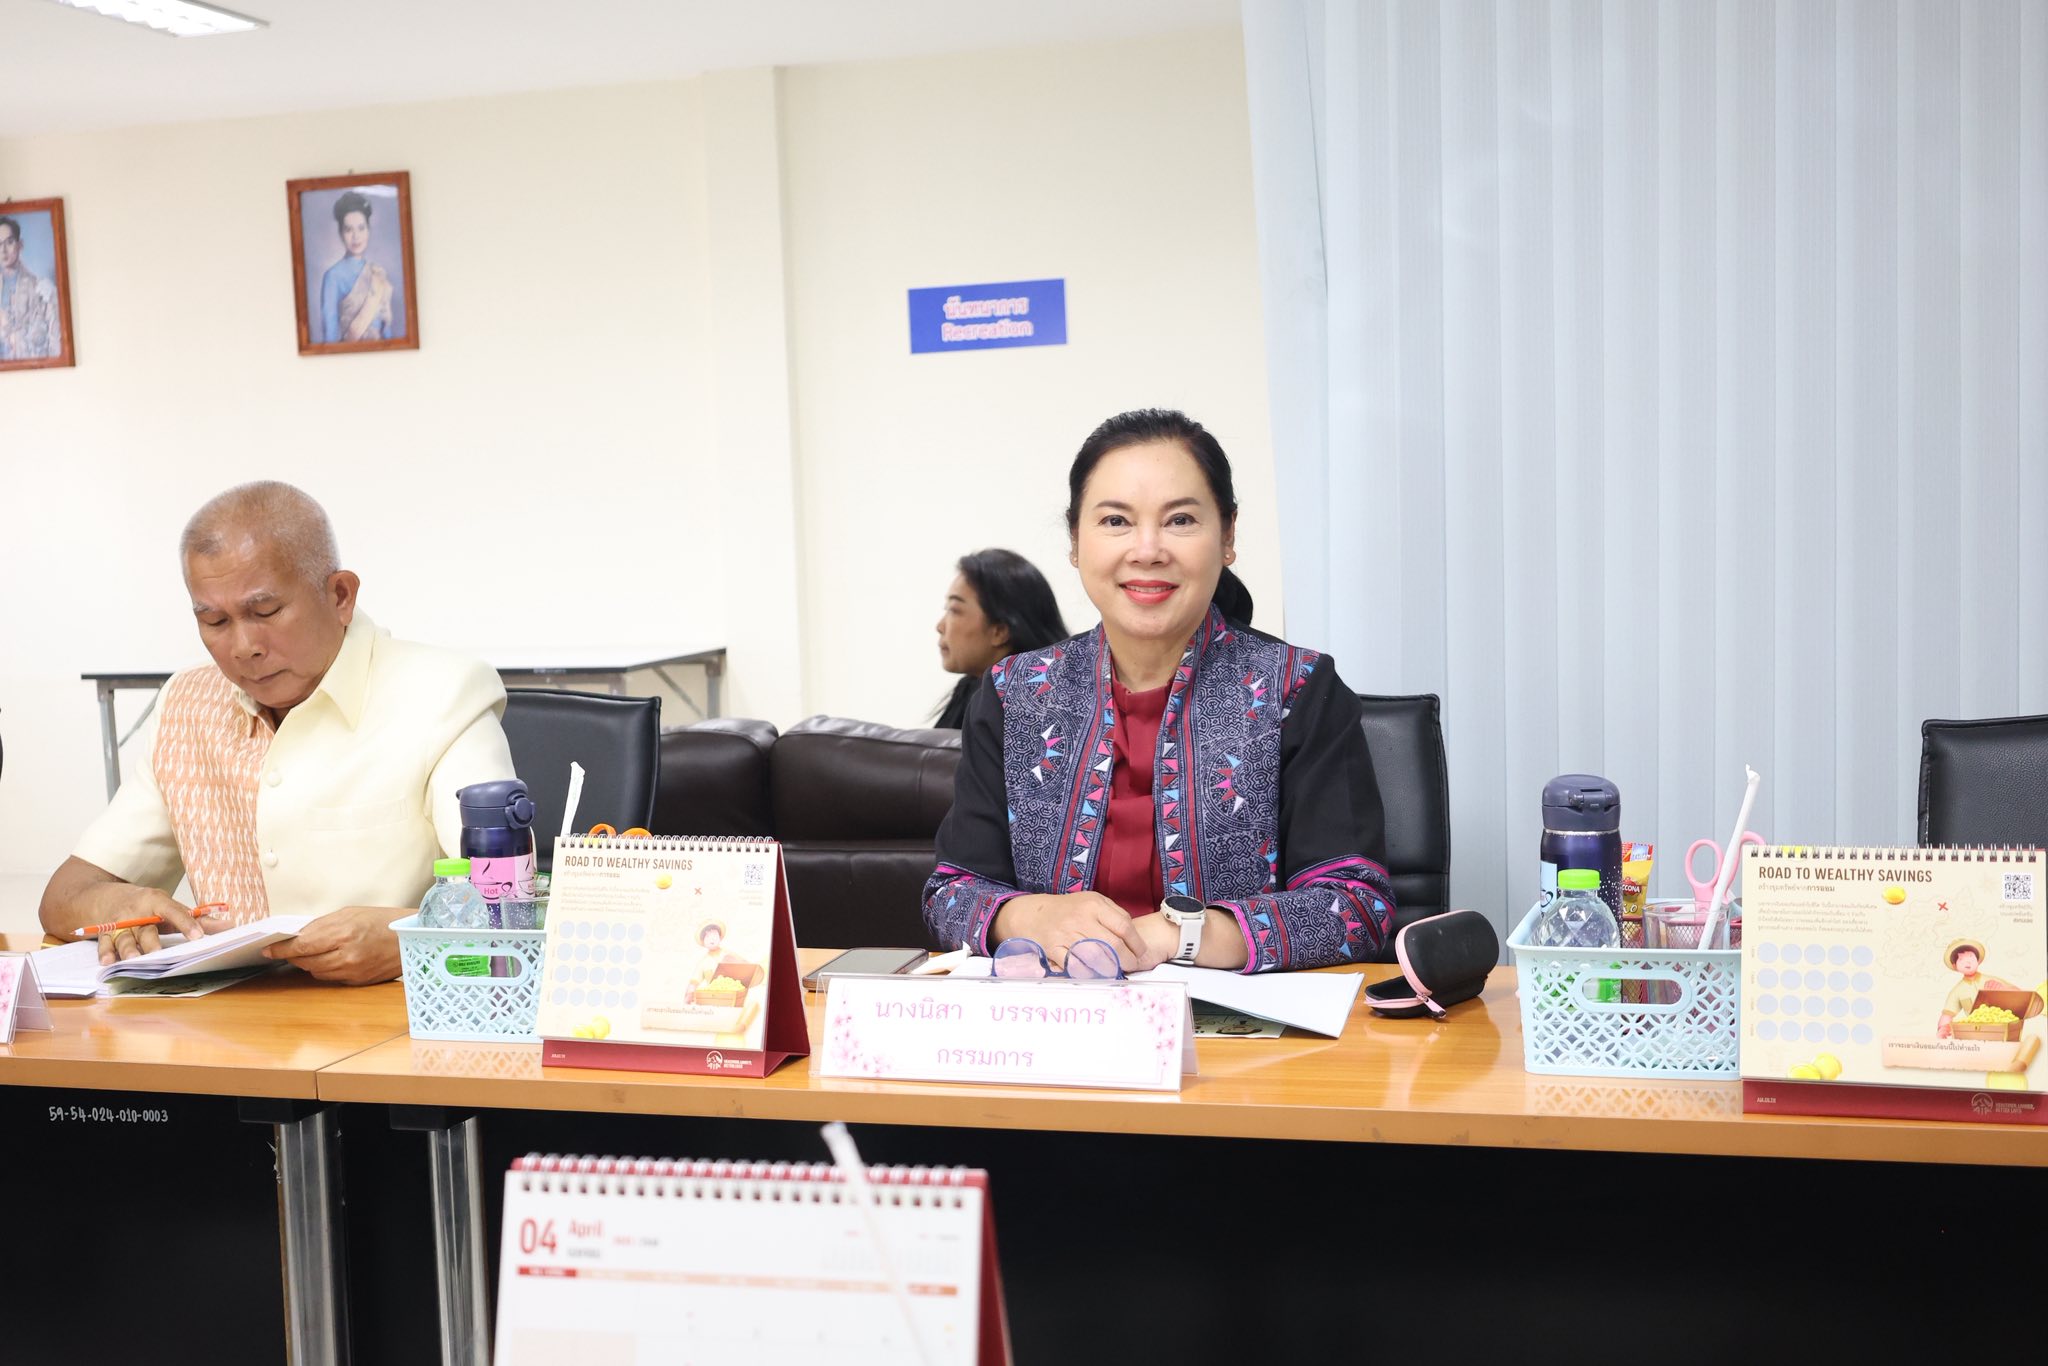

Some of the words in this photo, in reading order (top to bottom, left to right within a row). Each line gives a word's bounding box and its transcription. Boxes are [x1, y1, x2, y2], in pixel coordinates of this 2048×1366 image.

[942, 318, 1033, 342] Recreation
[565, 855, 589, 867] ROAD
[593, 856, 603, 867] TO
[606, 857, 651, 869] WEALTHY
[653, 858, 693, 871] SAVINGS
[1759, 866, 1792, 879] ROAD
[1796, 867, 1810, 879] TO
[1815, 868, 1874, 881] WEALTHY
[1878, 869, 1933, 883] SAVINGS
[484, 887, 498, 895] Hot
[875, 996, 963, 1022] นางนิสา
[990, 1002, 1107, 1025] บรรจงการ
[937, 1046, 1034, 1068] กรรมการ
[48, 1106, 169, 1123] 59-54-024-010-0003
[519, 1217, 557, 1255] 04
[568, 1218, 605, 1238] April
